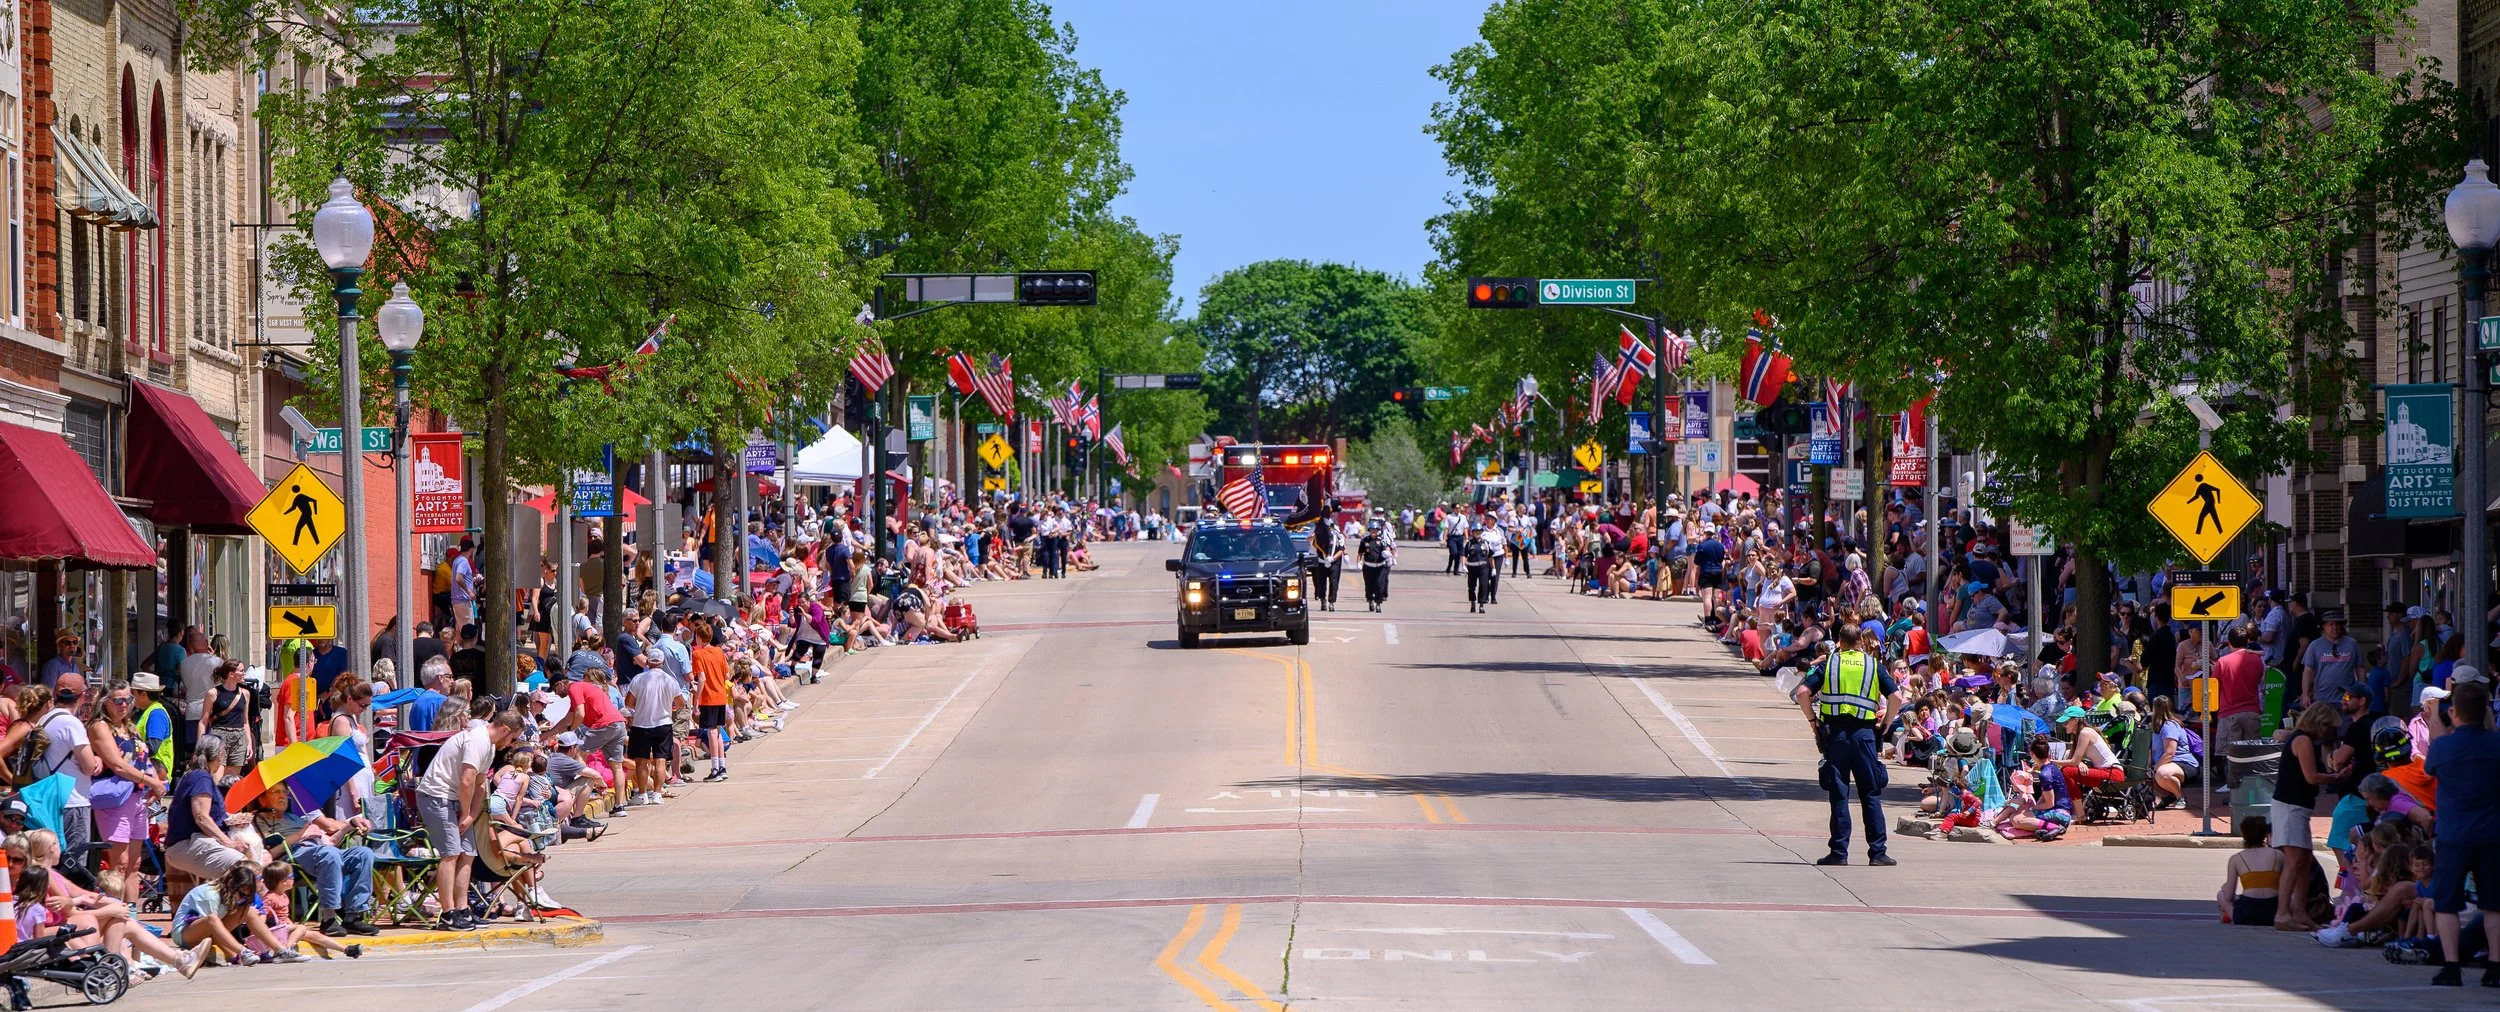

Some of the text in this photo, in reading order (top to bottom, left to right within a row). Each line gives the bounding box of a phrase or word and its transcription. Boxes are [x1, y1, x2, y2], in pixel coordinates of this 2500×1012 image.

[1562, 285, 1629, 299] Division St
[316, 431, 386, 449] Wat St
[2389, 475, 2434, 488] ARTS
[416, 502, 448, 511] ARTS
[2389, 497, 2453, 507] DISTRICT
[1302, 948, 1597, 963] ONLY
